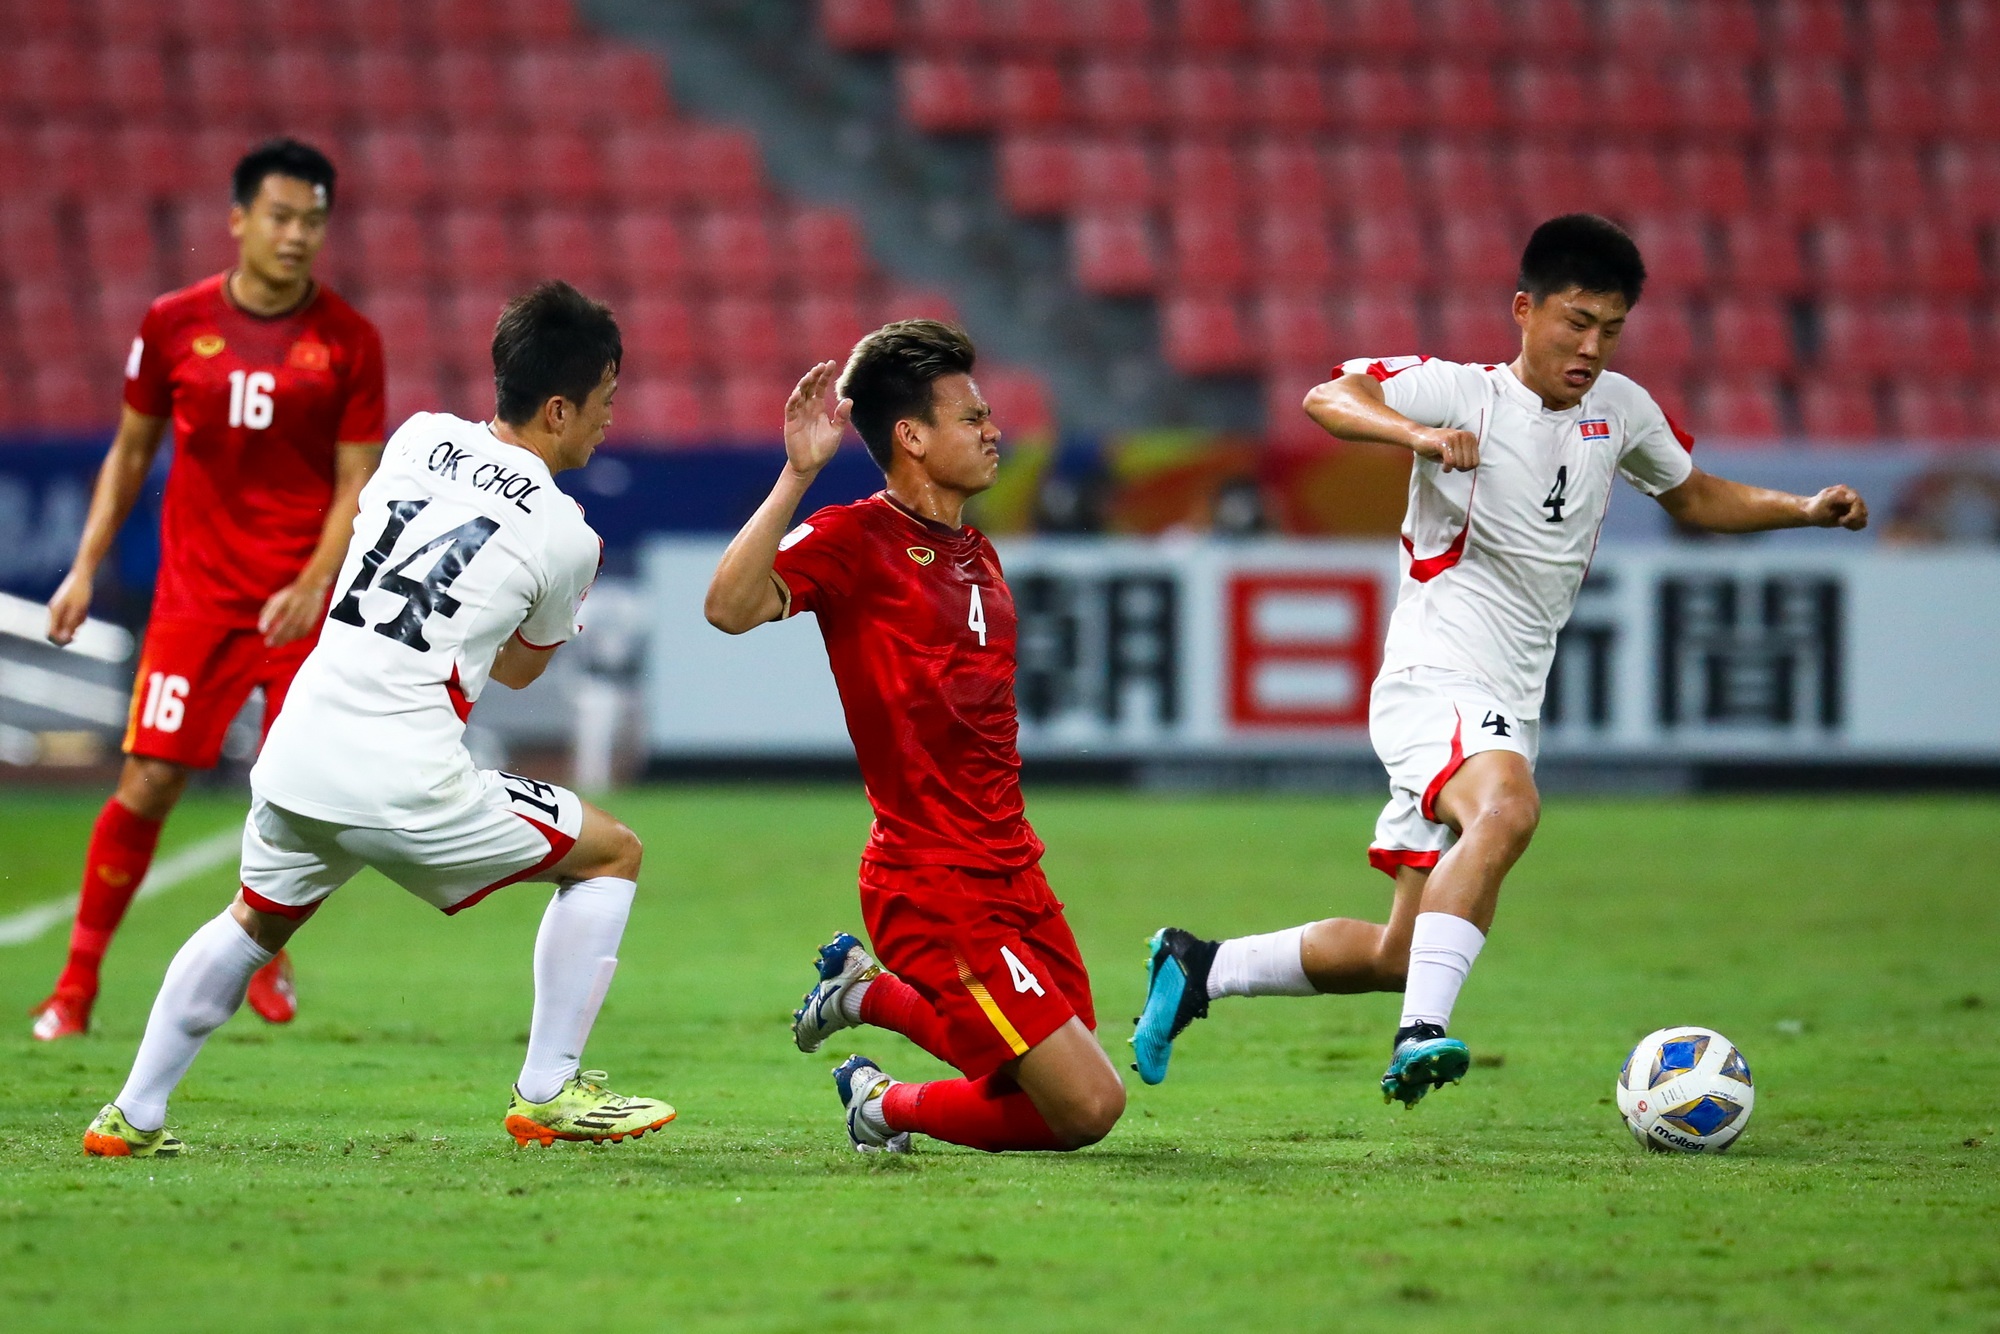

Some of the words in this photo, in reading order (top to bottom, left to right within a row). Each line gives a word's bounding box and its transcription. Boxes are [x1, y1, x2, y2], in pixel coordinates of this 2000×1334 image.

[228, 370, 276, 430] 16
[428, 441, 474, 481] OK
[472, 463, 541, 515] CHOL
[1542, 465, 1567, 523] 4
[329, 496, 501, 653] 14
[968, 583, 987, 647] 4
[141, 671, 190, 733] 16
[1481, 709, 1511, 738] 4
[498, 770, 559, 824] 14
[999, 945, 1046, 998] 4
[1654, 1125, 1706, 1151] molten
